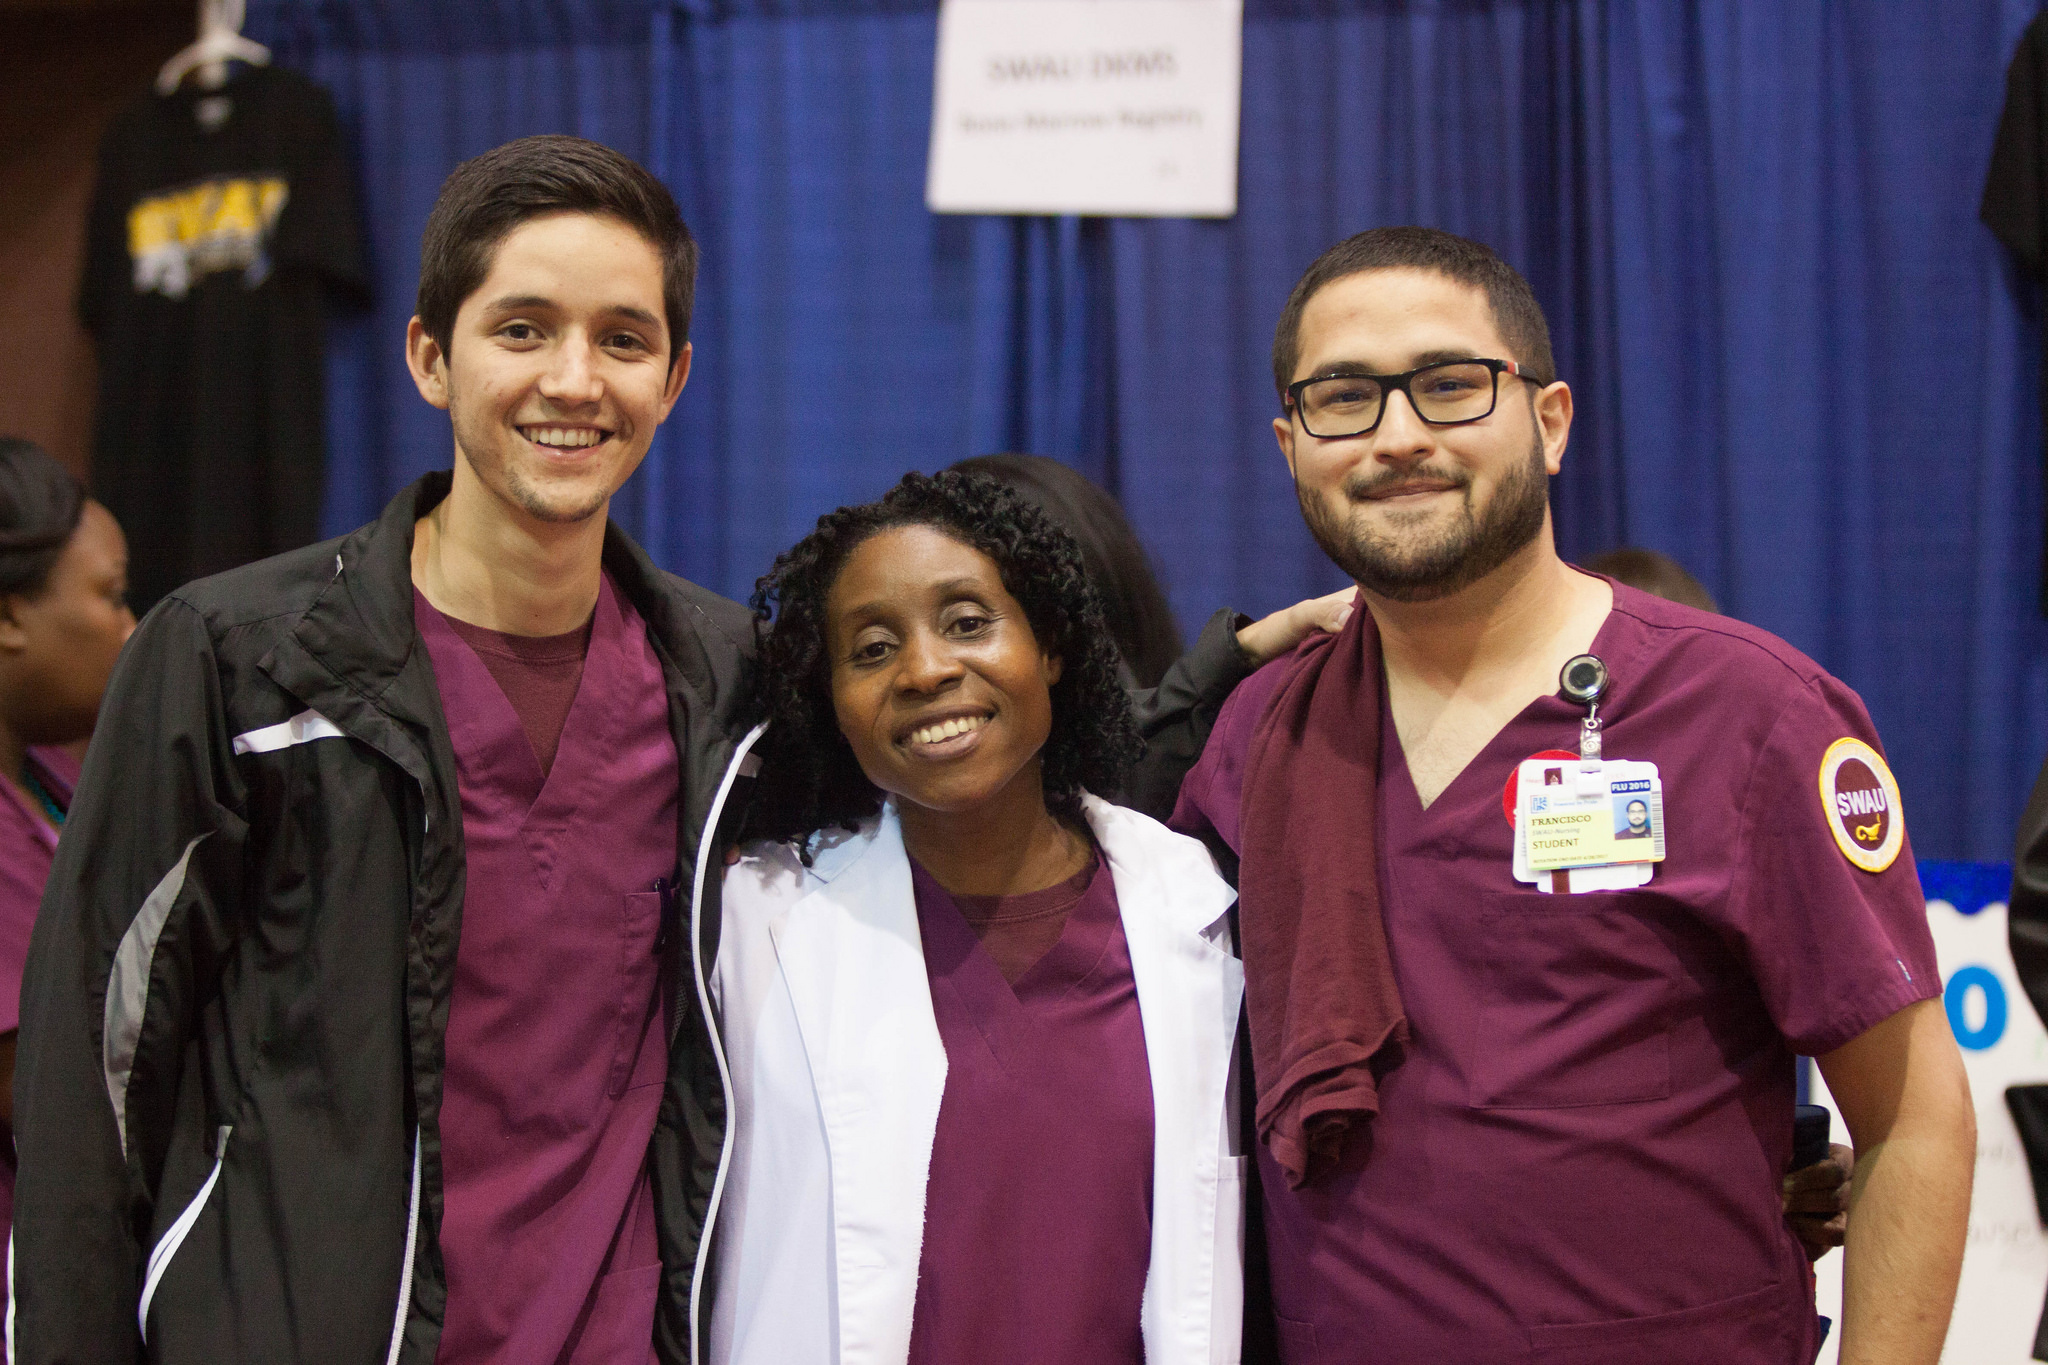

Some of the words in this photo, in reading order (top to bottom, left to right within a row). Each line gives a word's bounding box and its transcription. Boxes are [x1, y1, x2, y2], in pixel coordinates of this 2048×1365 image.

[1611, 782, 1627, 792] FLU
[1628, 780, 1650, 791] 2016
[1837, 788, 1886, 816] SWAU
[1531, 815, 1592, 826] FRANCISCO
[1532, 838, 1579, 850] STUDENT
